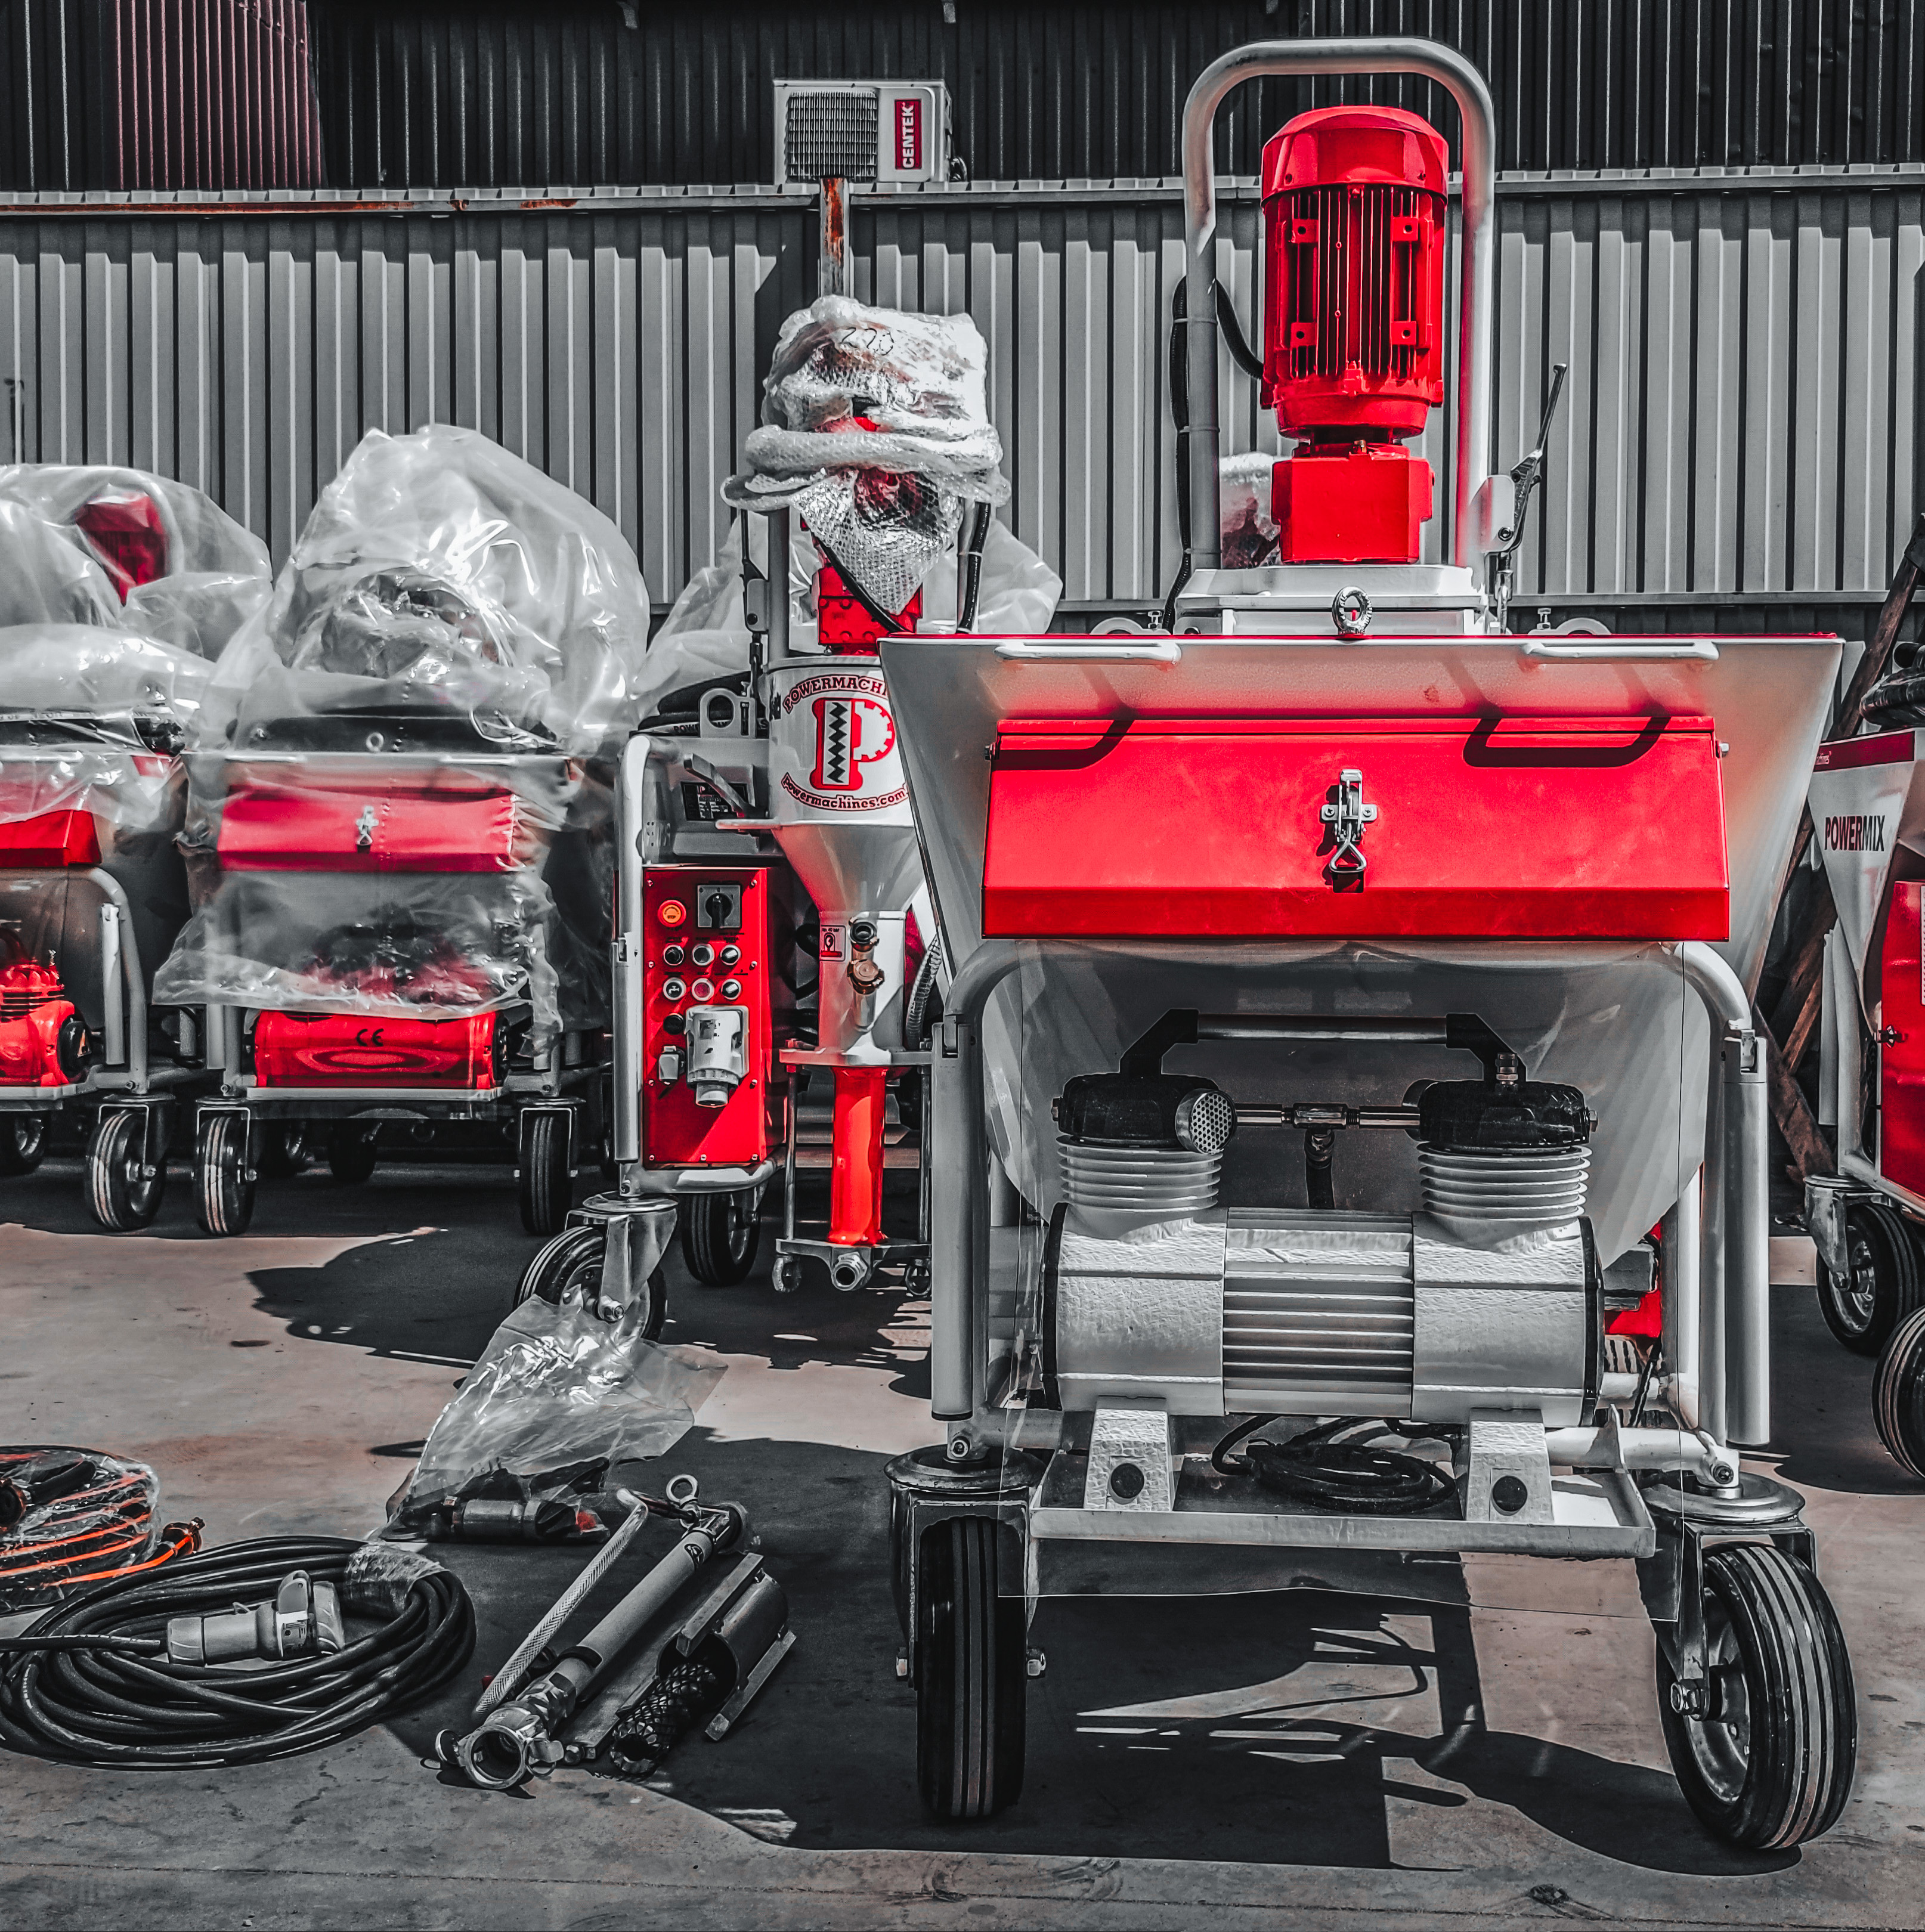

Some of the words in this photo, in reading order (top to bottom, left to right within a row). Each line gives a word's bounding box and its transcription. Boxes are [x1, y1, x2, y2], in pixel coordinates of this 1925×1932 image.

[902, 101, 915, 169] CENTEK
[1824, 815, 1886, 852] POWERMIX
[355, 1028, 385, 1047] CE
